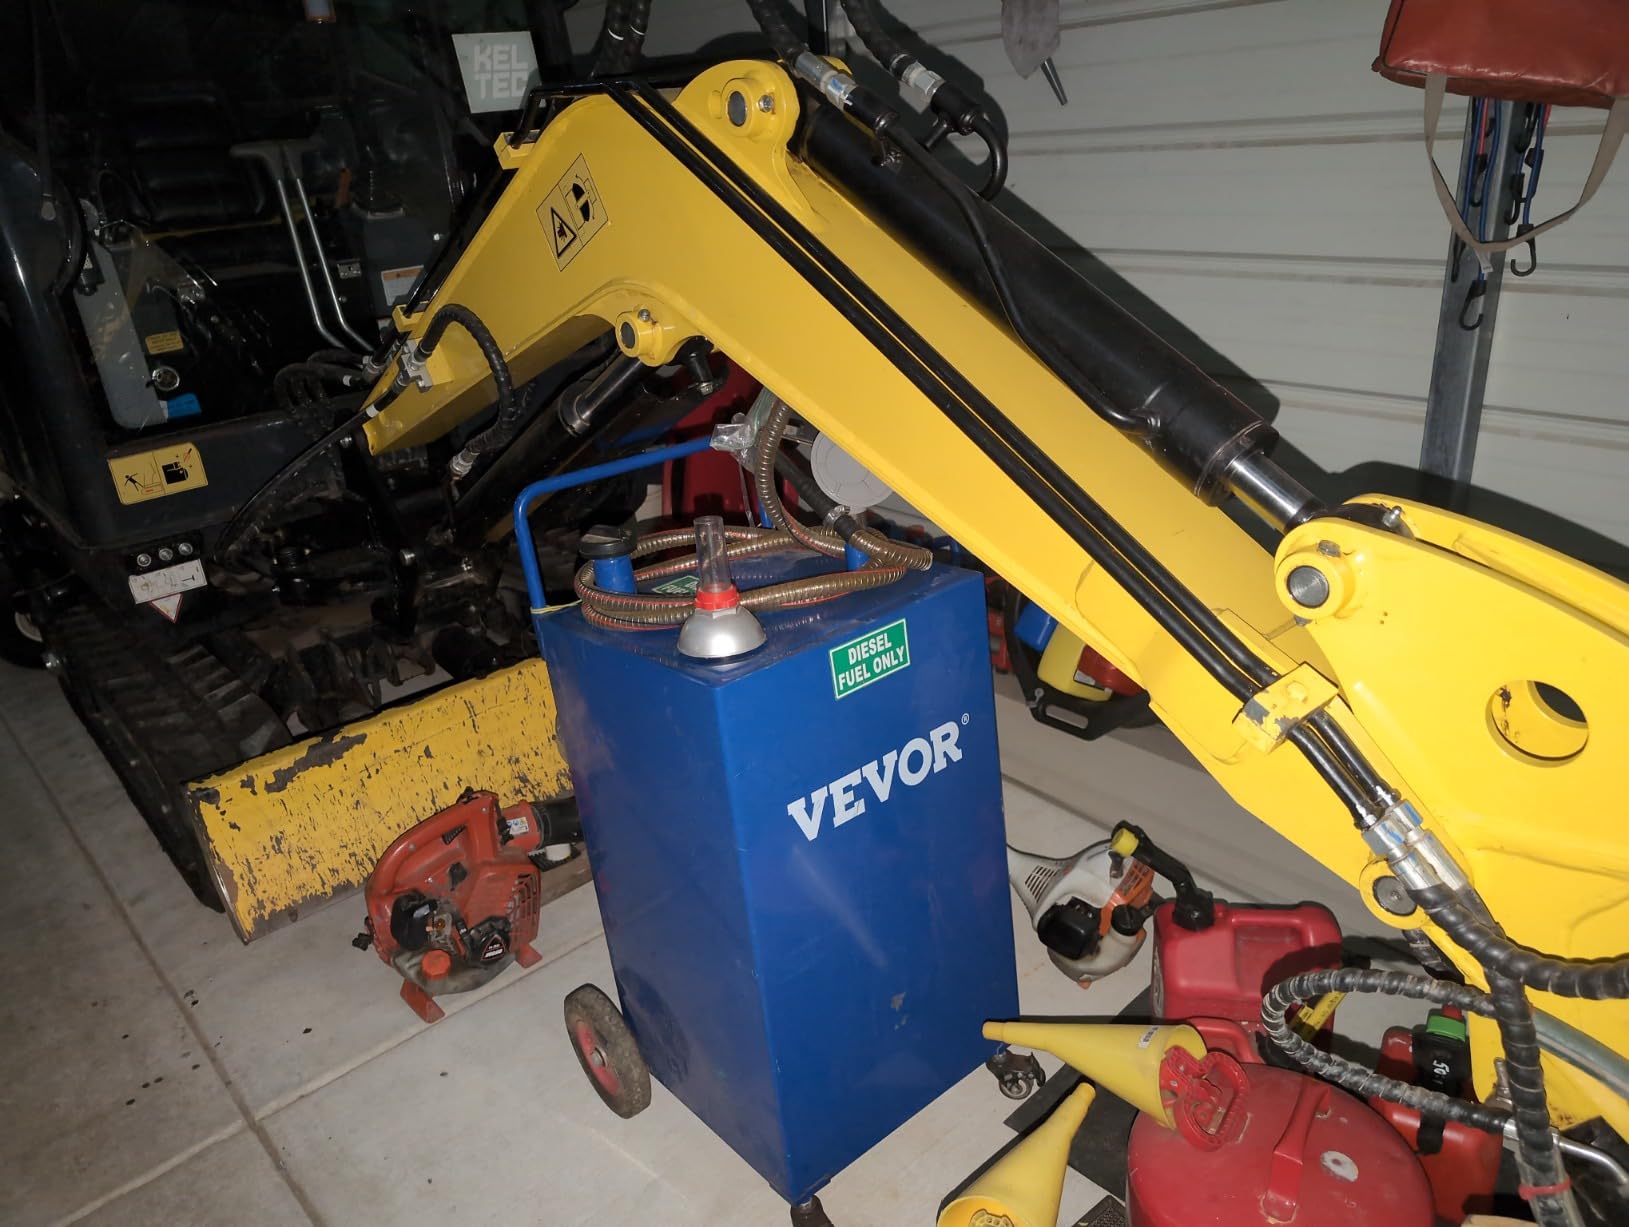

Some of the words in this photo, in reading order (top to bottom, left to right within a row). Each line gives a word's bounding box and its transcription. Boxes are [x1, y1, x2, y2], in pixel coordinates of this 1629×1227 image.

[474, 44, 528, 71] KEL
[475, 71, 527, 97] TEC
[848, 633, 892, 665] DIESEL
[838, 663, 871, 690] FUEL
[873, 645, 905, 673] ONLY
